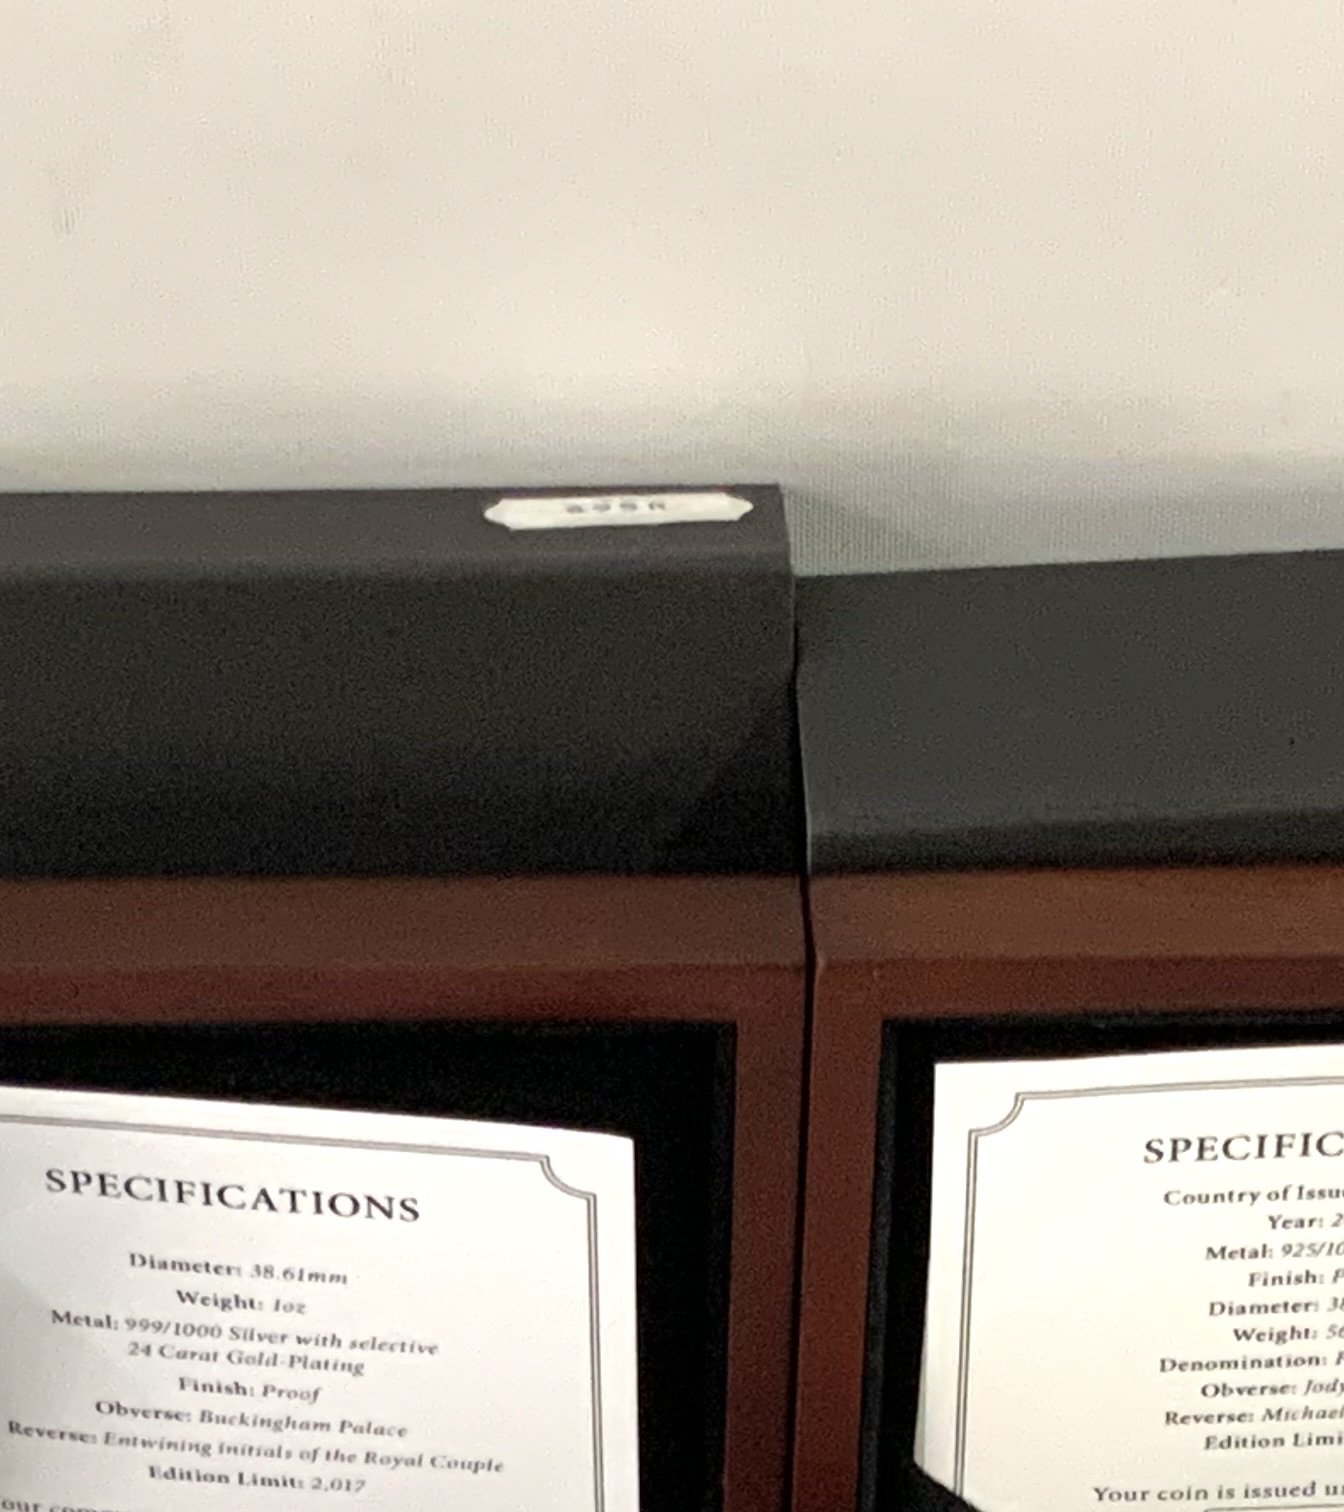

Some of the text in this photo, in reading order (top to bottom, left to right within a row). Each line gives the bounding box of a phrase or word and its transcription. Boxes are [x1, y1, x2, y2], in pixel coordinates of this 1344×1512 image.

[45, 1167, 421, 1223] SPECIFICATIONS
[1163, 1186, 1261, 1208] Country
[1266, 1185, 1290, 1202] of
[1268, 1215, 1324, 1231] Year:
[1205, 1245, 1274, 1262] Metal:
[128, 1252, 348, 1285] Diameter: 38.61mm
[1248, 1271, 1325, 1287] Finish:
[176, 1289, 264, 1314] Weight:
[1209, 1301, 1318, 1317] Diameter:
[51, 1309, 439, 1356] Metal: 999/1000 Silver with selective
[1234, 1328, 1317, 1345] Weight:
[128, 1341, 152, 1358] 24
[159, 1345, 219, 1363] Carat
[1159, 1356, 1327, 1373] Denomination:
[178, 1377, 323, 1403] Finish: Proof
[1201, 1382, 1297, 1399] Obverse:
[94, 1400, 409, 1439] Obverse: Buckingham Palace
[1165, 1412, 1253, 1427] Reverse:
[7, 1421, 504, 1474] Reverse: Entwining initials of the Royal Couple
[1203, 1435, 1285, 1451] Edition
[148, 1466, 231, 1486] Edition
[238, 1472, 305, 1489] Limit:
[1094, 1486, 1149, 1504] Your
[1155, 1485, 1209, 1501] coin
[1216, 1485, 1236, 1500] is
[1243, 1481, 1317, 1499] issued
